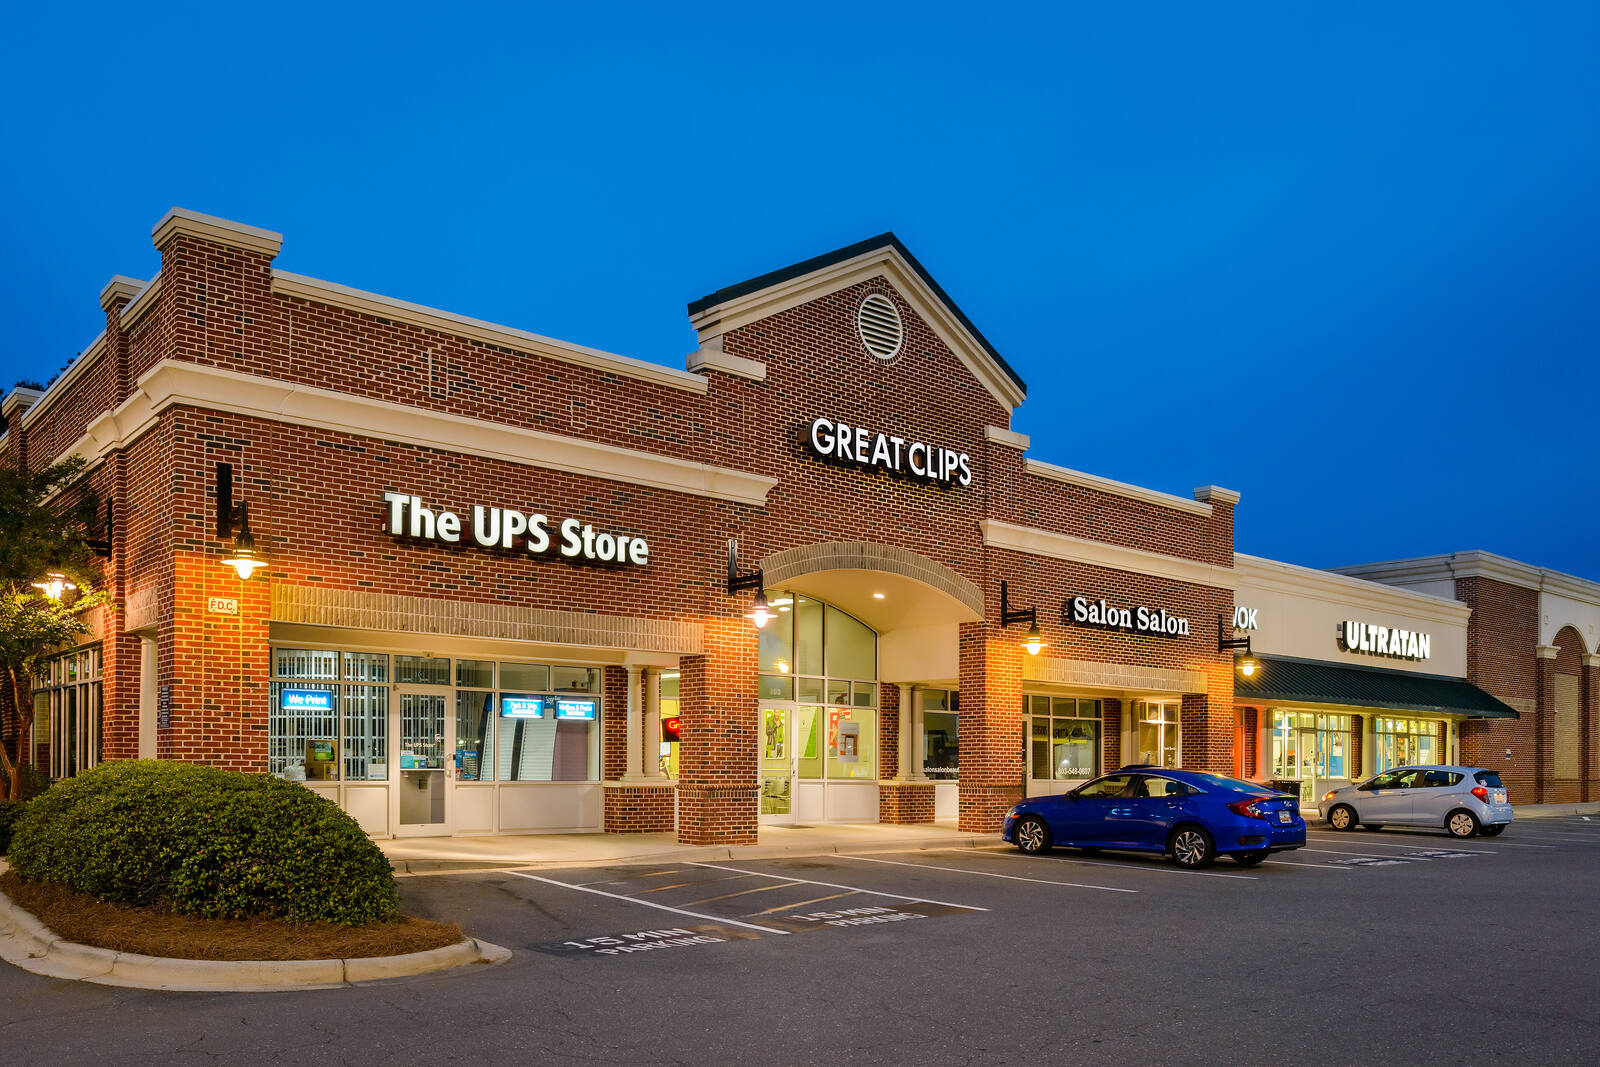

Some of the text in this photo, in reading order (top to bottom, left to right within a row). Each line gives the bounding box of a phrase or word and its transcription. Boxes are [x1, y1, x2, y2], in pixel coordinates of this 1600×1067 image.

[811, 418, 972, 486] GREAT CLIPS
[384, 491, 649, 565] The UPS Store
[1074, 597, 1189, 635] Salon Salon
[1346, 620, 1430, 659] ULTRATAN
[288, 694, 327, 706] We Print
[563, 927, 697, 949] 15 MIN
[595, 935, 727, 955] PARKING
